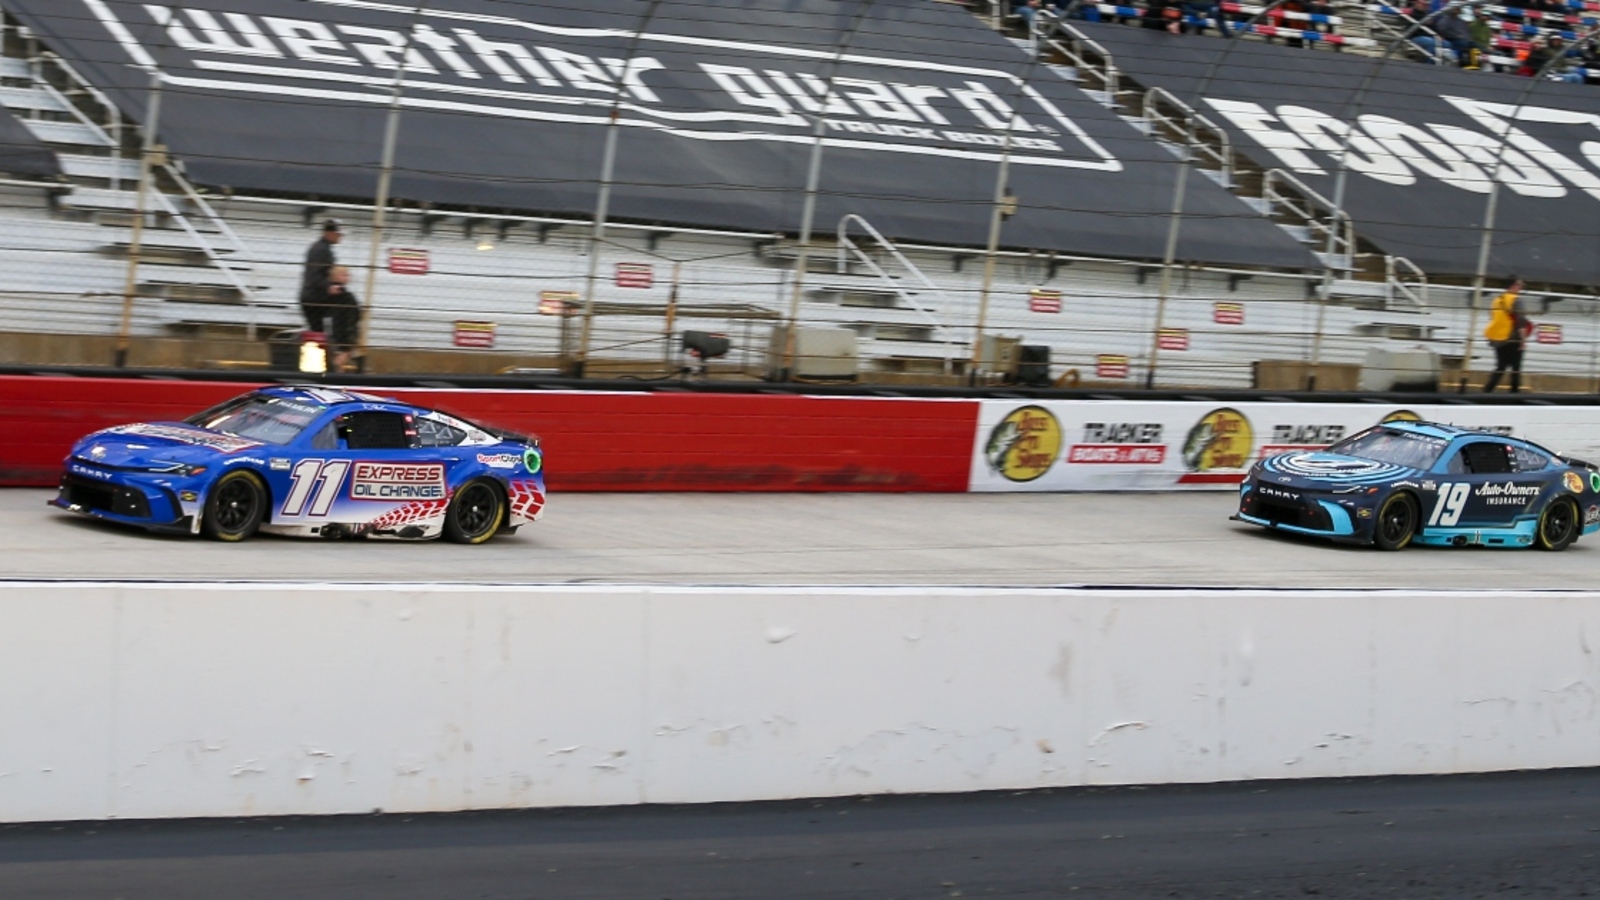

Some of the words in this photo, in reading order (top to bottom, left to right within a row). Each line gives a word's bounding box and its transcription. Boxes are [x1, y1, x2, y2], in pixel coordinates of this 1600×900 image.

[822, 119, 945, 141] TRUCK
[939, 129, 1065, 152] BOXES
[1202, 97, 1568, 198] FOOD
[1082, 423, 1163, 443] TRACKER
[356, 465, 441, 481] EXPRESS
[279, 458, 351, 519] 11
[353, 483, 377, 497] OIL
[379, 485, 443, 498] CHANGE
[1259, 486, 1300, 500] CAMRY
[1475, 480, 1541, 496] Auto-Owners
[1427, 482, 1471, 527] 19
[1486, 496, 1526, 506] INSURANCE
